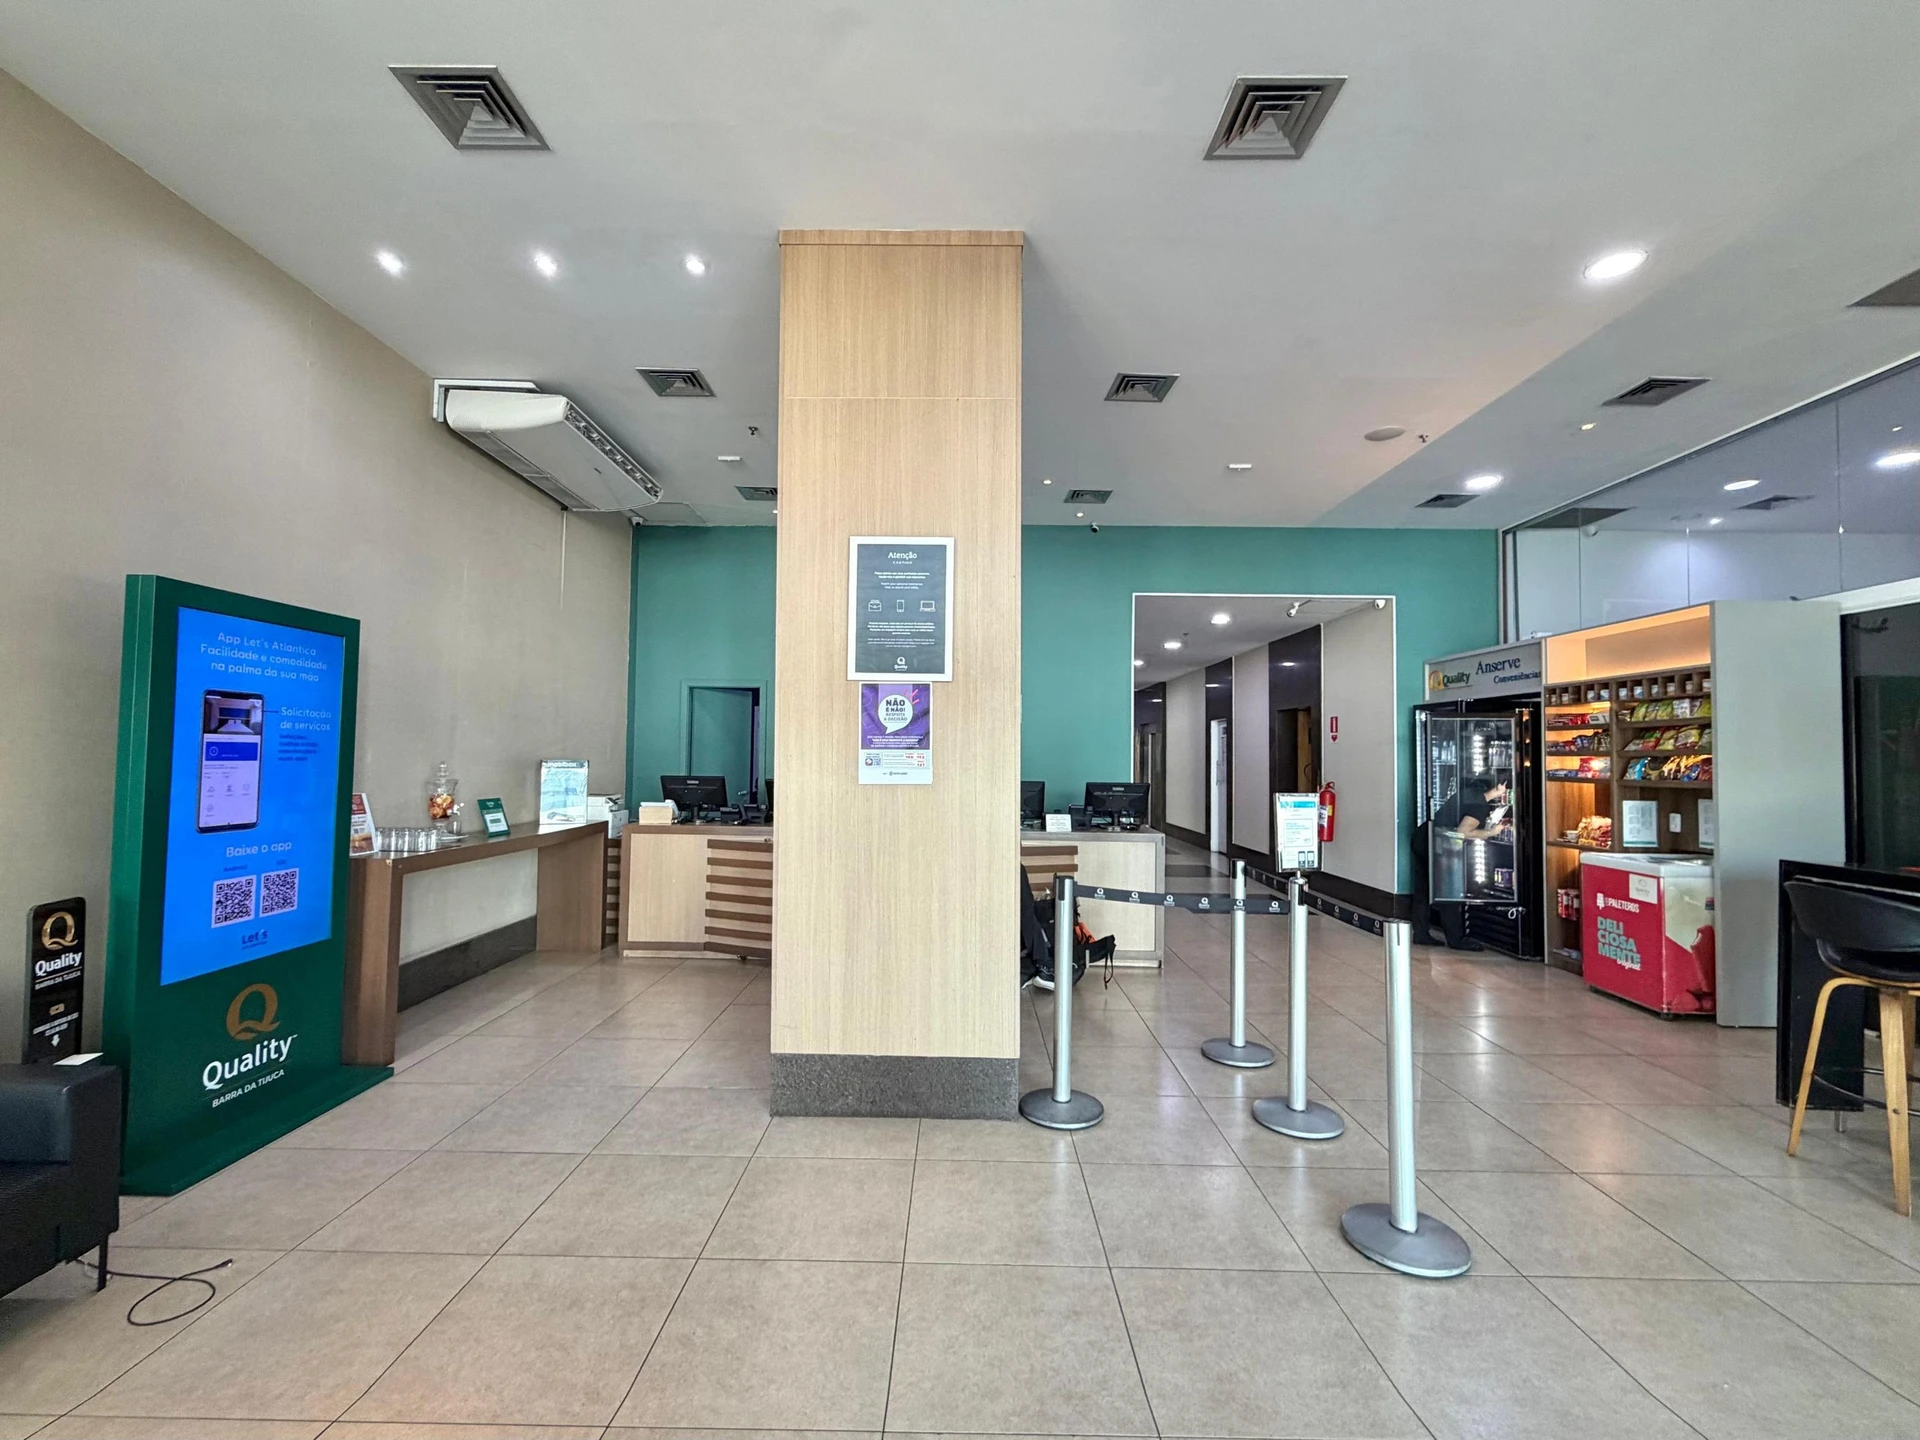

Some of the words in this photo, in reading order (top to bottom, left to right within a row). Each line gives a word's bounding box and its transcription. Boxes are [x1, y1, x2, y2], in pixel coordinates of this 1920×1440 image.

[888, 551, 918, 560] Atenção
[217, 632, 241, 646] App
[243, 635, 269, 649] Let's
[200, 643, 259, 661] Facilidade
[260, 654, 267, 662] e
[269, 655, 328, 670] comodidade
[211, 662, 225, 671] na
[228, 661, 262, 675] palma
[264, 667, 277, 677] da
[280, 671, 297, 679] sua
[300, 671, 319, 682] mão
[1475, 657, 1520, 675] Anserve
[1442, 672, 1471, 687] Quality
[885, 697, 905, 707] NÃO
[281, 706, 332, 719] Solicitação
[280, 720, 292, 729] de
[294, 722, 331, 731] serviços
[226, 844, 259, 857] Baixe
[261, 844, 269, 852] o
[271, 841, 292, 853] app
[1608, 898, 1640, 913] PALETEROS
[1597, 916, 1624, 935] DELI
[1597, 929, 1637, 952] CIOSA
[1598, 942, 1641, 964] MENTE
[35, 951, 83, 977] Quality
[202, 1035, 293, 1091] Quality
[212, 1088, 243, 1108] BARRA
[244, 1081, 257, 1093] DA
[258, 1069, 285, 1087] TIJUCA
